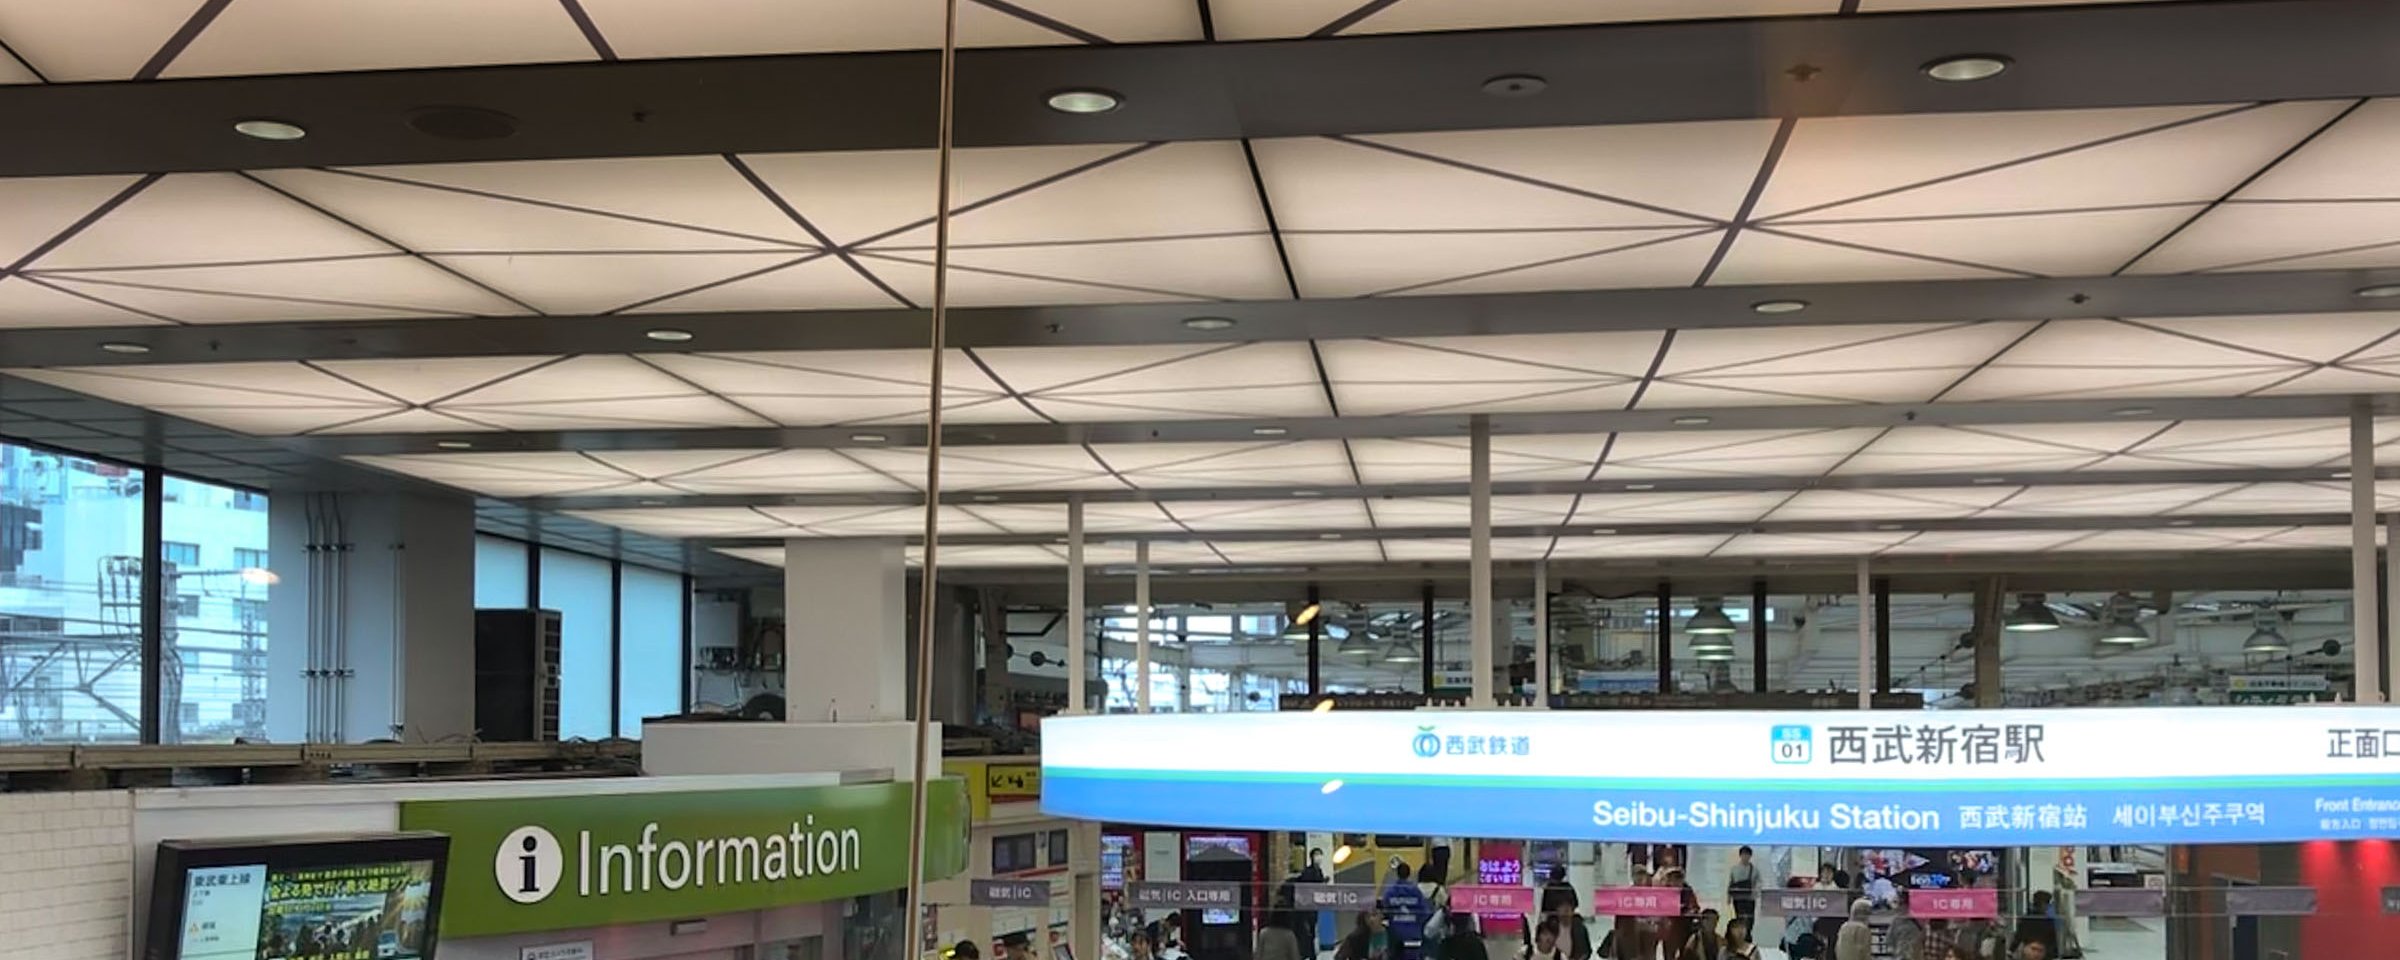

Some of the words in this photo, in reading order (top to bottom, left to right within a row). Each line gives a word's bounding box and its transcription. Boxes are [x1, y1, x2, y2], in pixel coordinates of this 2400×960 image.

[1446, 735, 1530, 755] 西武鉄道
[1781, 743, 1803, 758] 01
[1827, 724, 2045, 764] 西武新宿駅
[1593, 800, 1819, 834] Seibu-Shinjuku
[1830, 803, 1940, 830] Station
[1959, 804, 2088, 829] 西武新宿站
[2113, 802, 2266, 828] 세이부신주쿠역
[2315, 799, 2349, 812] Front
[579, 814, 861, 897] Information
